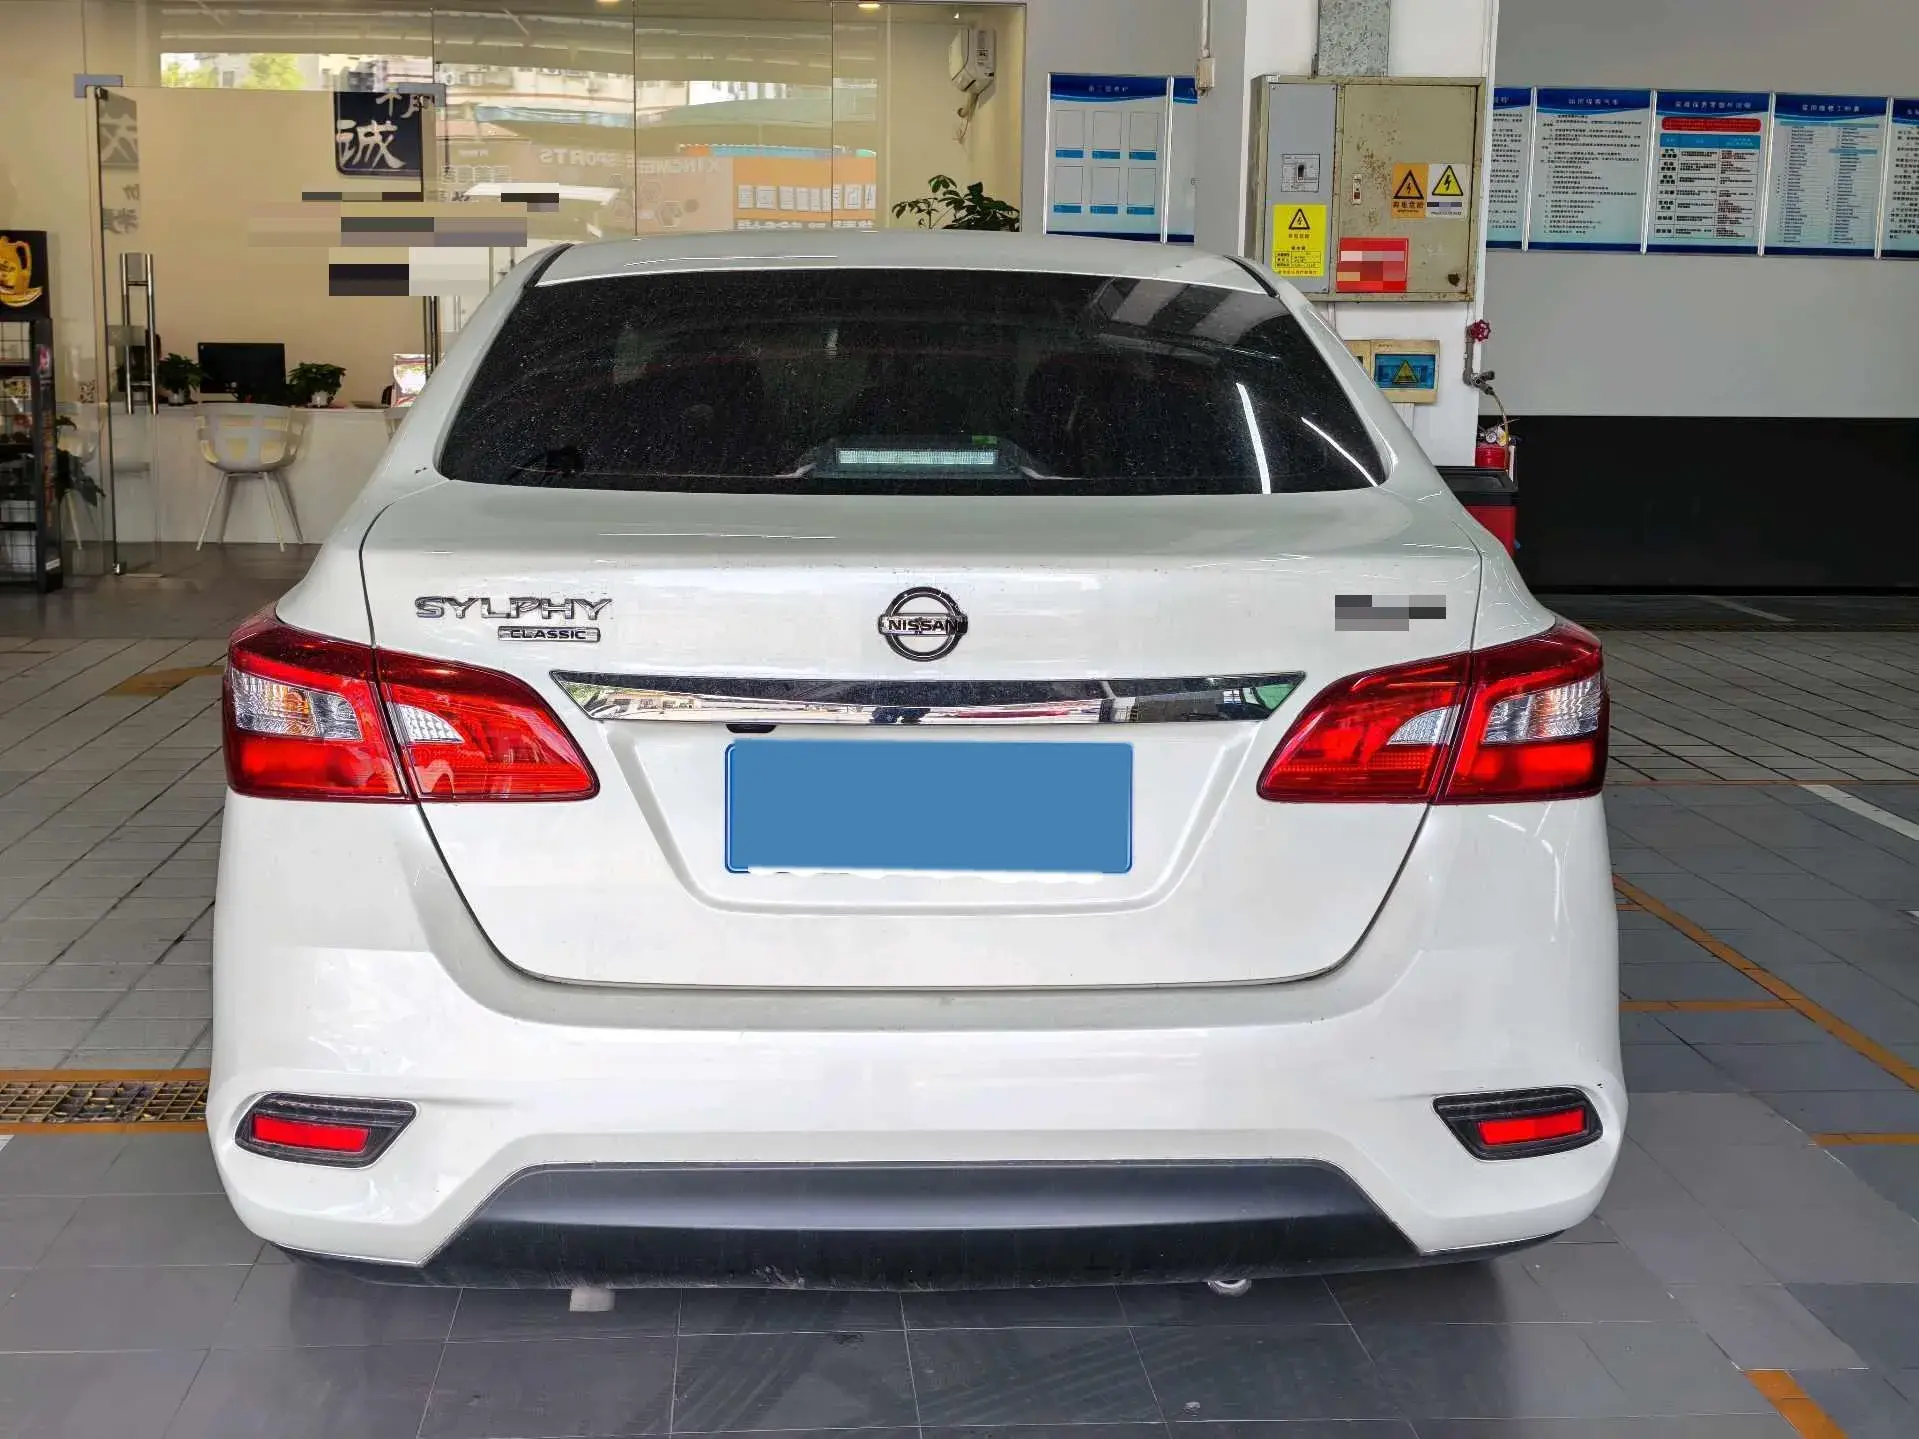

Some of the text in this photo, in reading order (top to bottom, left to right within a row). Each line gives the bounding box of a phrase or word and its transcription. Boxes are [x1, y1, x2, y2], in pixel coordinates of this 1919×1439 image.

[414, 596, 613, 621] SYLPHY
[887, 618, 958, 633] NISSAN
[509, 628, 588, 641] CLASSIC
